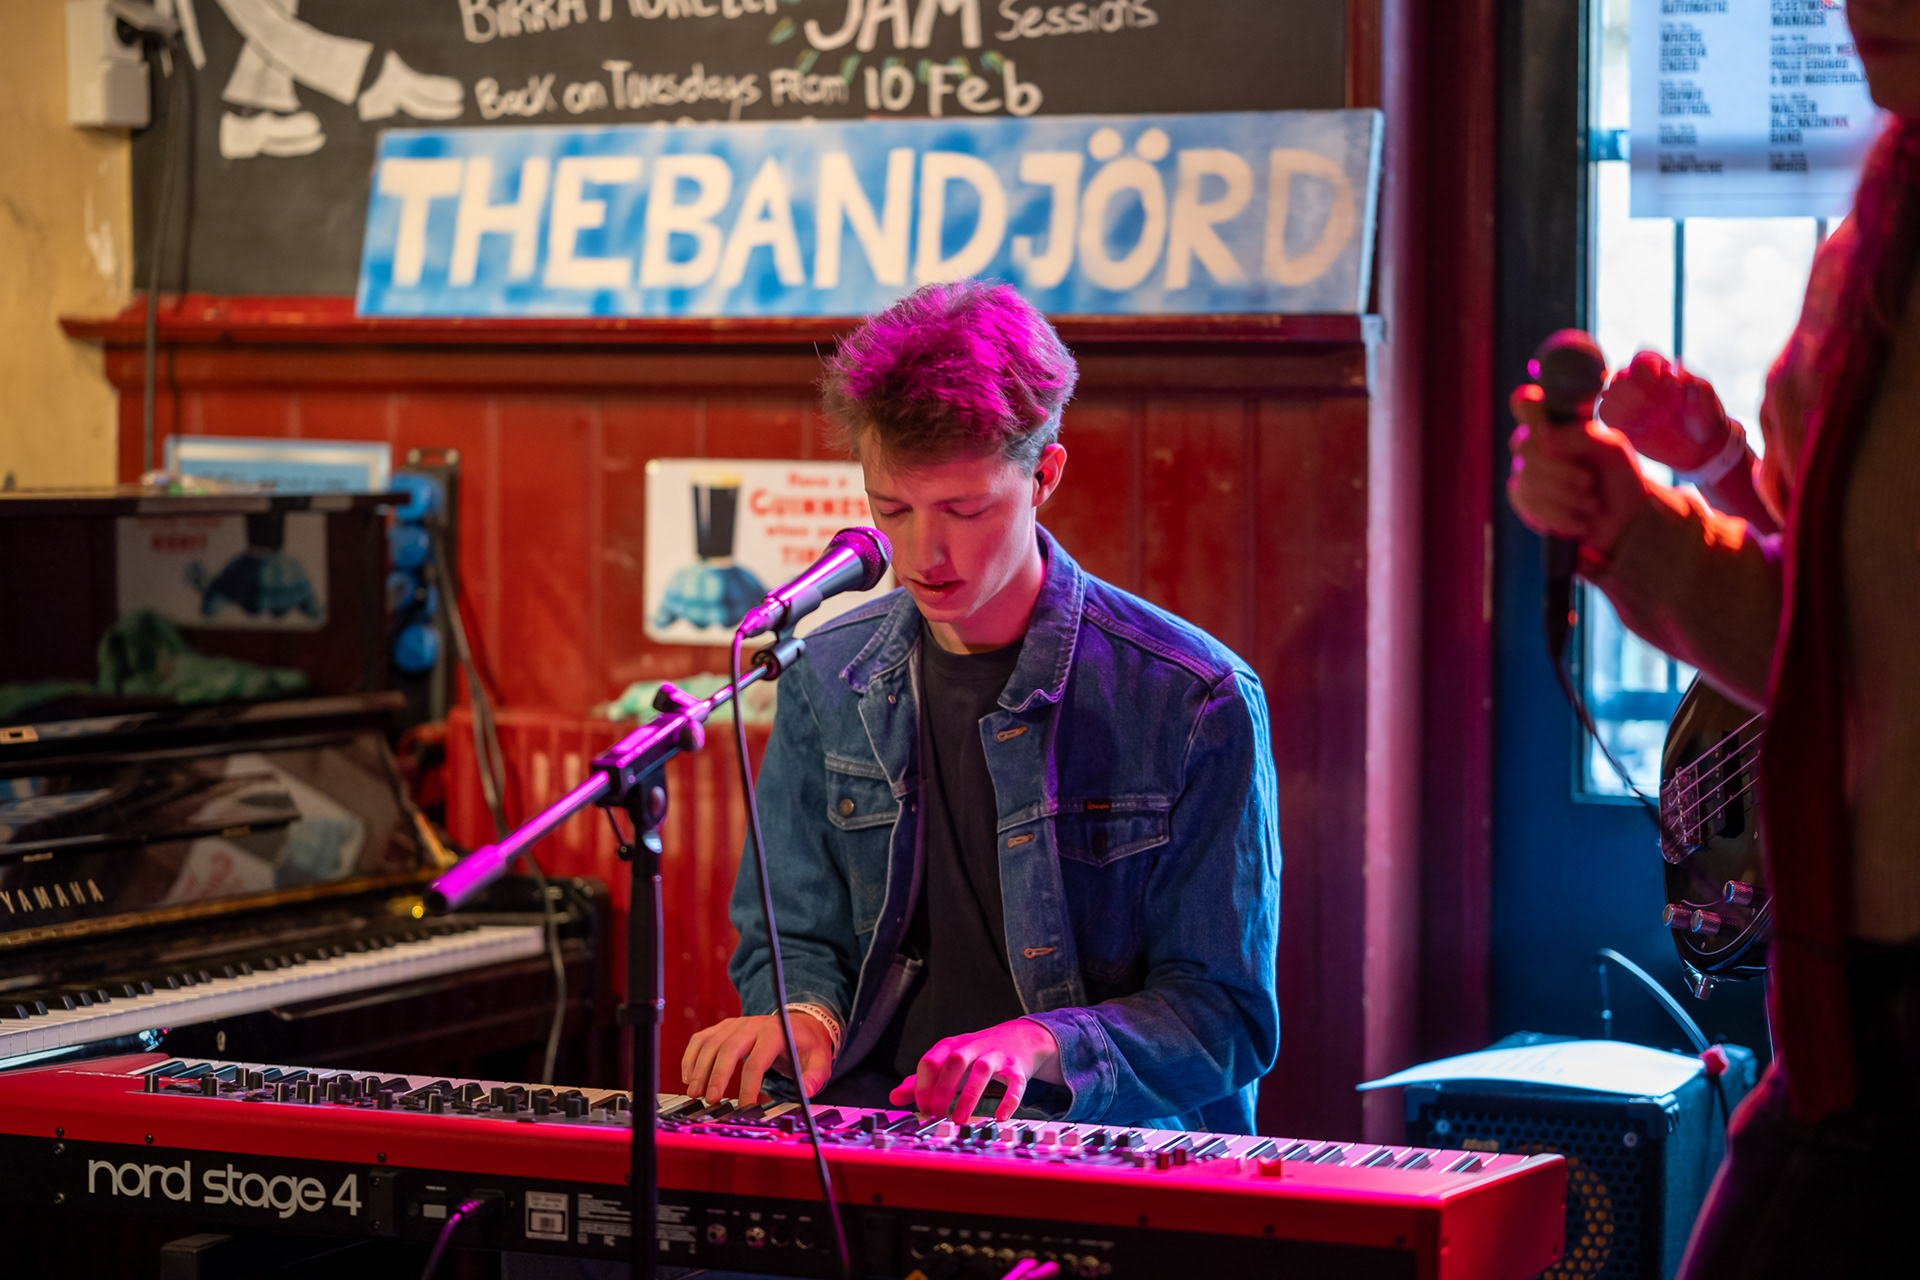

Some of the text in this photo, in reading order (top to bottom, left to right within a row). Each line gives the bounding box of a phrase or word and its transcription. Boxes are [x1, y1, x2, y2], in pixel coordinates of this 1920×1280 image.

[804, 0, 982, 50] JAM
[475, 75, 557, 120] Back
[563, 82, 608, 114] on
[601, 60, 762, 121] Tuesdays
[864, 66, 914, 111] 10
[926, 60, 1043, 116] Feb
[0, 878, 104, 914] YAMAHA
[88, 1159, 362, 1219] nord stage 4
